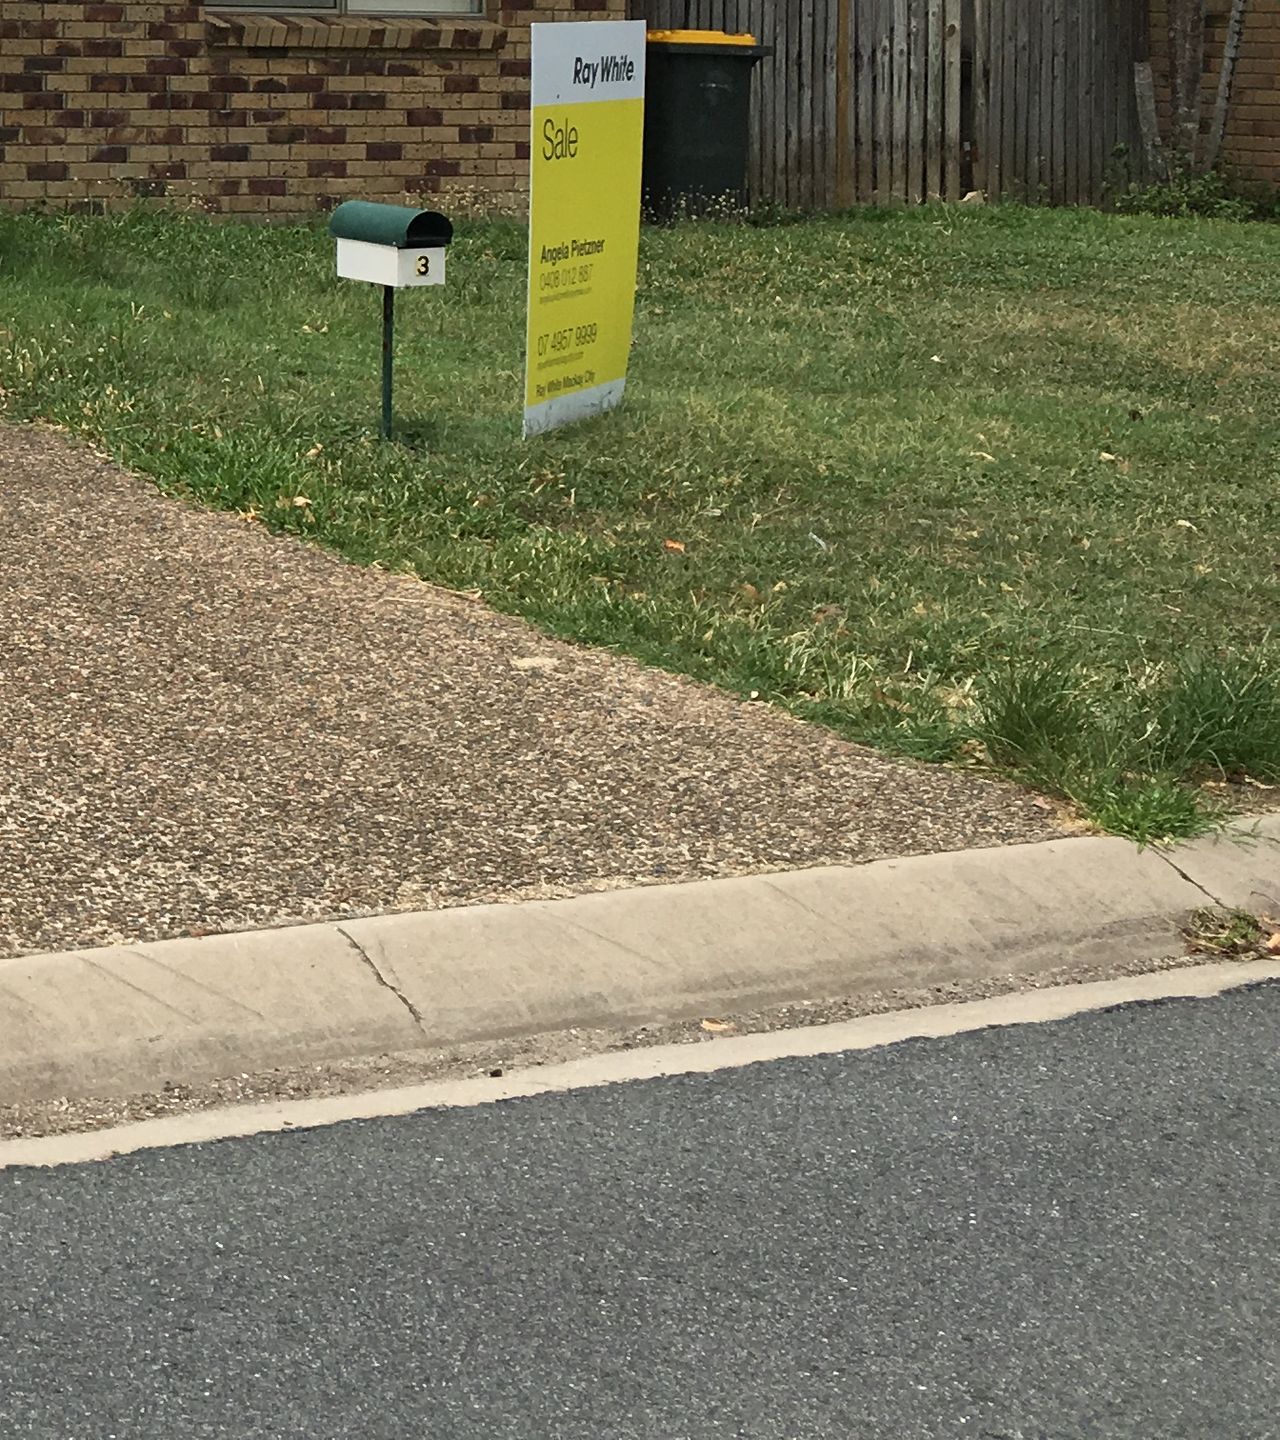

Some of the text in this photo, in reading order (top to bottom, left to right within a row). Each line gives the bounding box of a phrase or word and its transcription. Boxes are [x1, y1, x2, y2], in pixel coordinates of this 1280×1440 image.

[573, 54, 634, 88] Ray White
[542, 118, 578, 161] Sale
[417, 255, 429, 275] 3
[540, 242, 569, 266] Angela
[538, 333, 549, 356] 07
